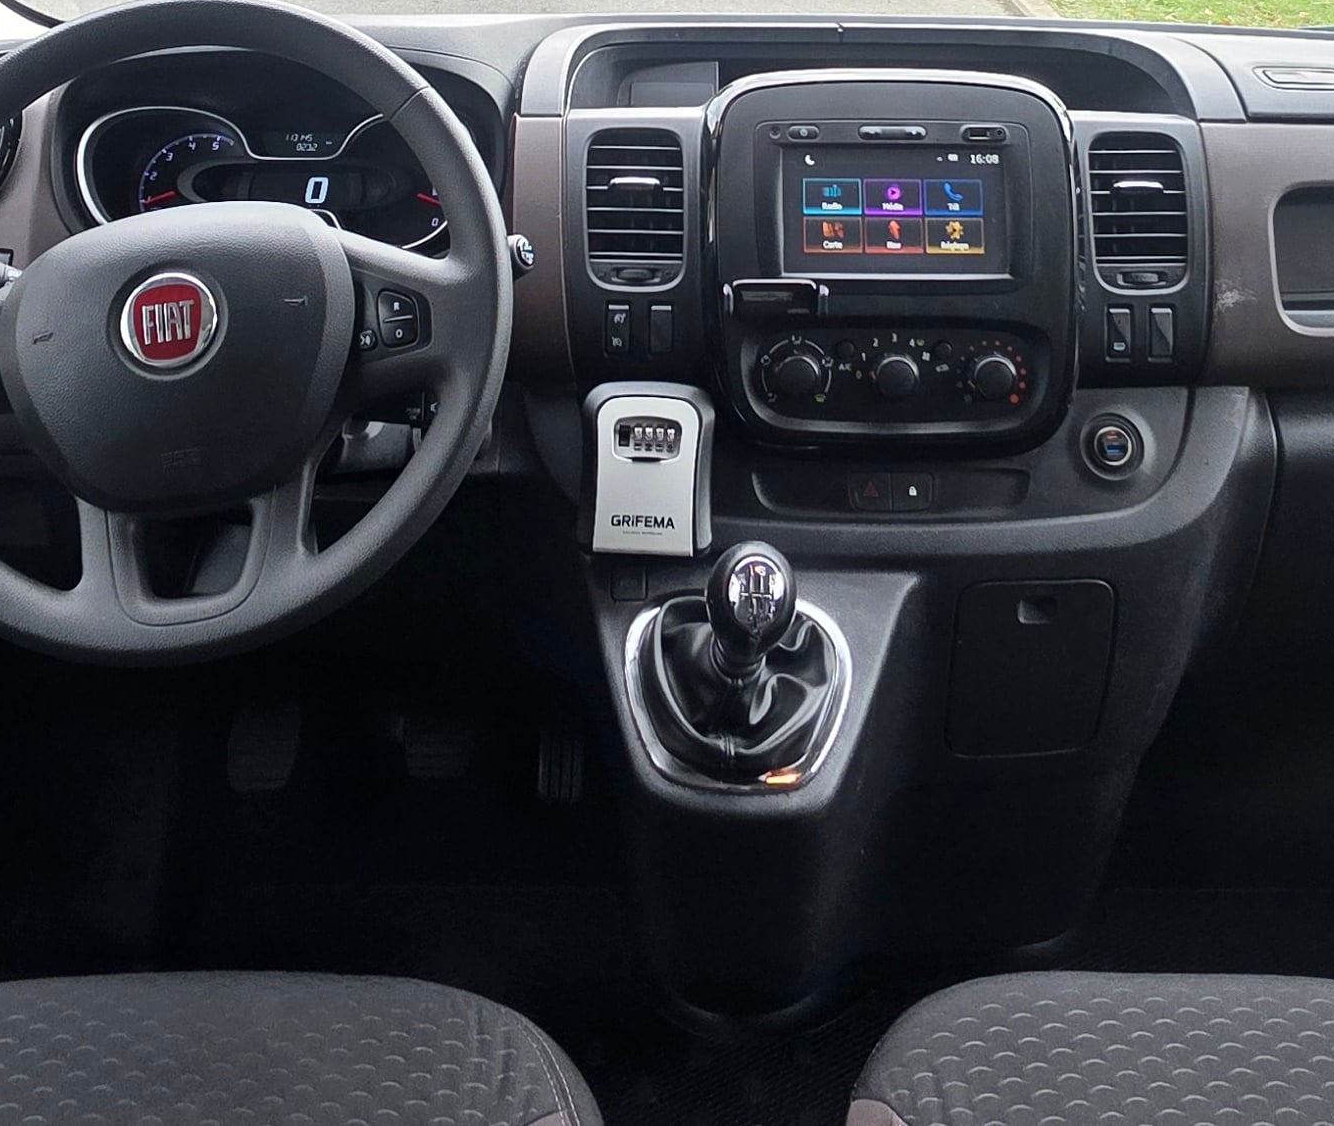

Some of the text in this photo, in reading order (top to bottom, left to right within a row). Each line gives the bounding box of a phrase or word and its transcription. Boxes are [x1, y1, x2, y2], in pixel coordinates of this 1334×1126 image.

[188, 142, 196, 150] 4
[211, 141, 220, 151] 5
[165, 152, 174, 162] 3
[149, 172, 158, 181] 2
[305, 176, 329, 204] 0
[431, 217, 439, 227] 0
[142, 299, 195, 346] FIAT
[872, 337, 879, 347] 2
[909, 338, 916, 347] 4
